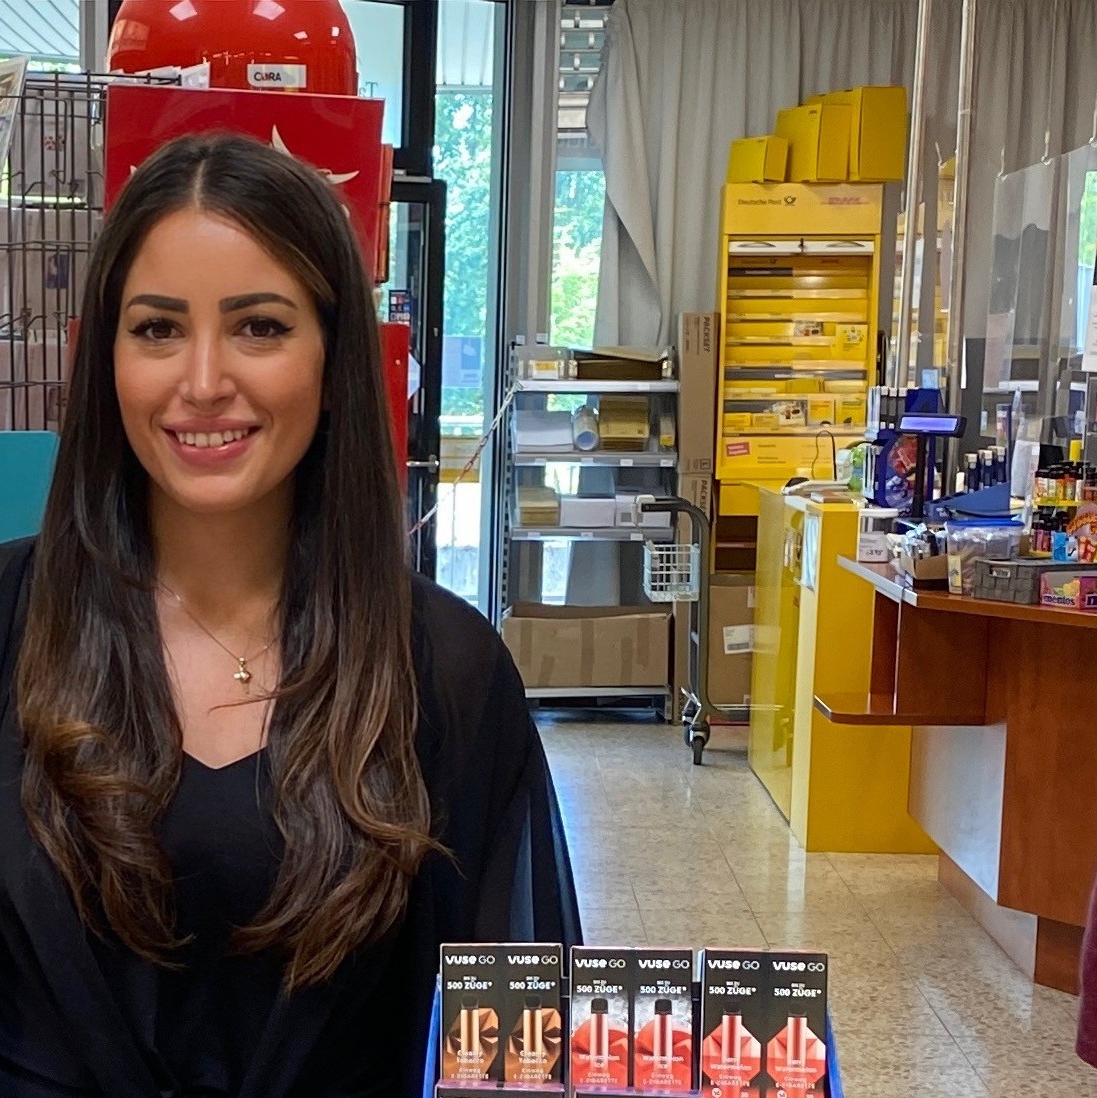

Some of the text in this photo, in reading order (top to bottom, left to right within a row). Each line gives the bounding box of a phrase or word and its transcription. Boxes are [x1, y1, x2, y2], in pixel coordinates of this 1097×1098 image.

[478, 956, 496, 965] GO
[541, 956, 558, 965] GO
[608, 958, 626, 968] GO
[672, 960, 690, 970] GO
[742, 960, 760, 970] GO
[808, 962, 826, 972] GO
[446, 981, 463, 990] 500
[509, 981, 526, 990] 500
[576, 985, 593, 994] 500
[640, 986, 656, 994] 500
[709, 986, 725, 995] 500
[774, 988, 790, 998] 500
